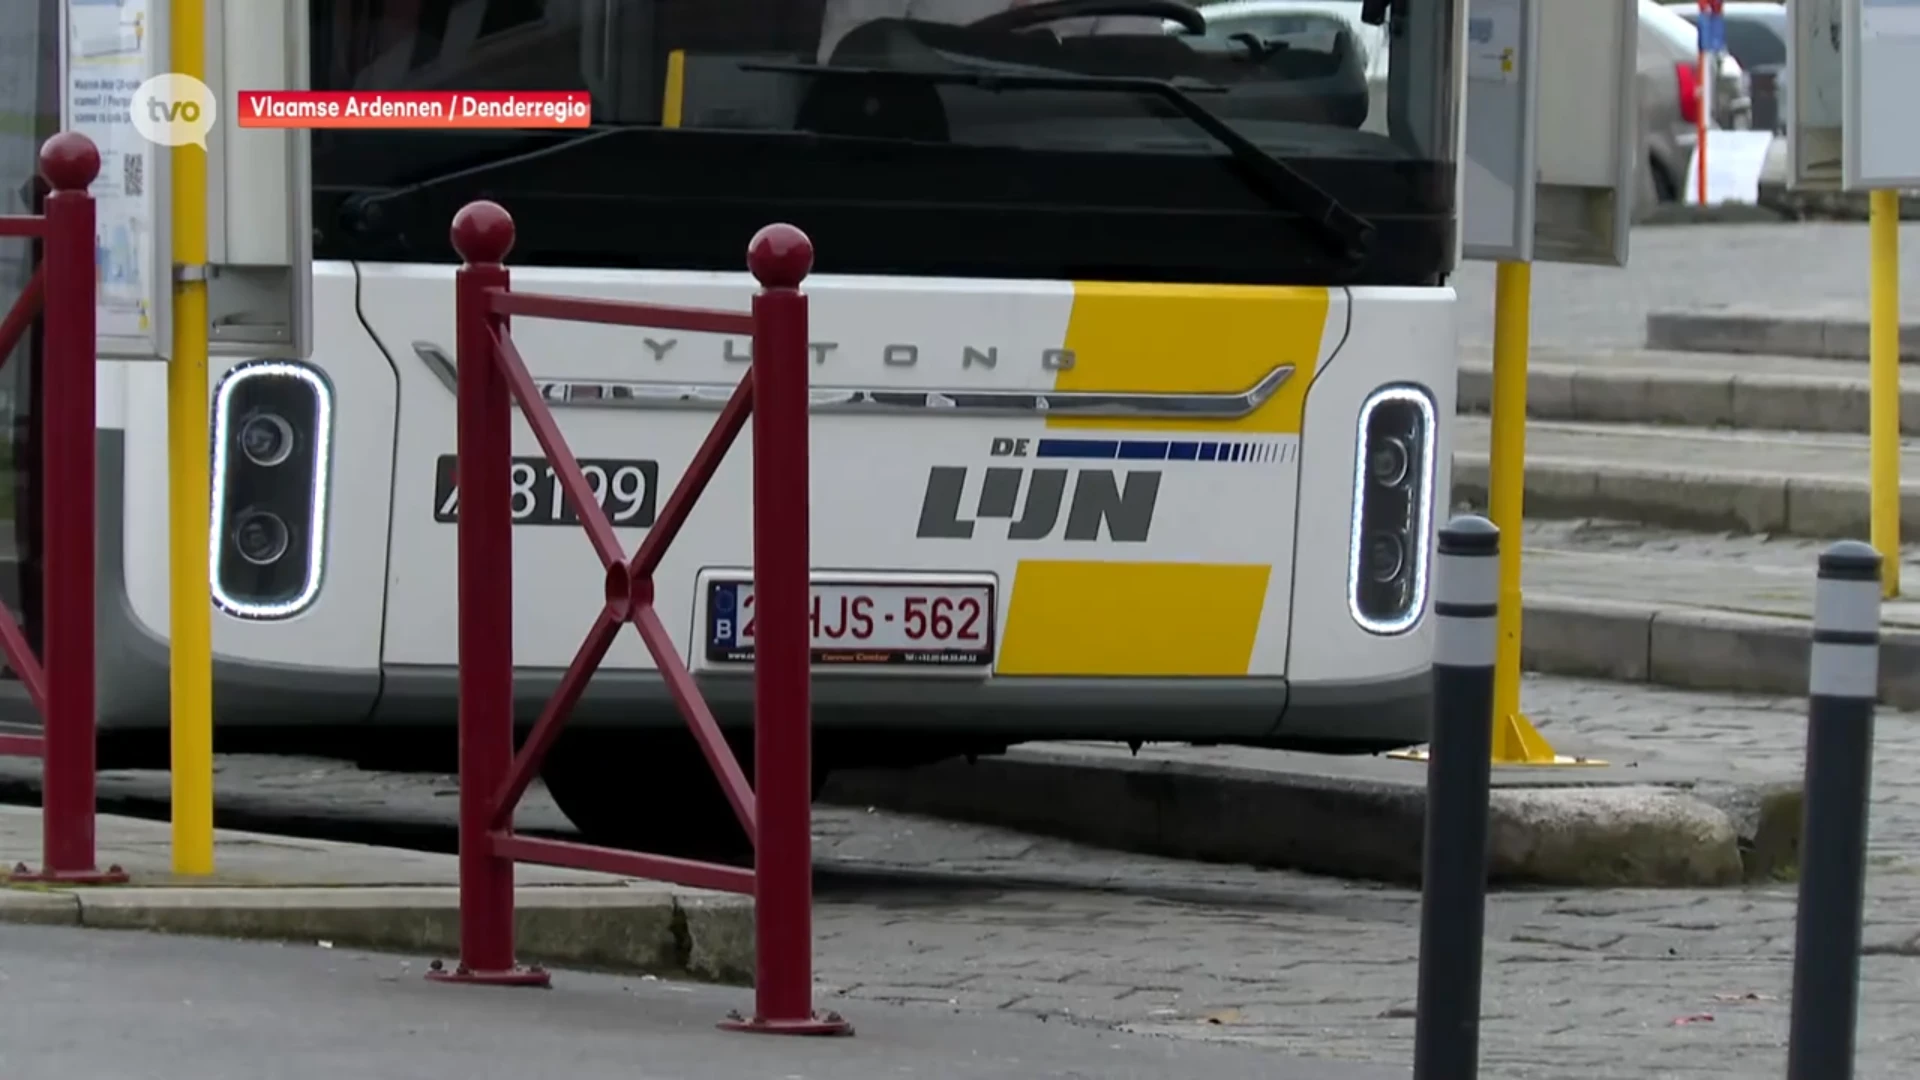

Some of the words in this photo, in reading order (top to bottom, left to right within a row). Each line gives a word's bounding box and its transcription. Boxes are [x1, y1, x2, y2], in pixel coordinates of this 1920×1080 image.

[990, 437, 1030, 457] DE
[916, 466, 1162, 542] LIJN
[716, 619, 732, 639] B
